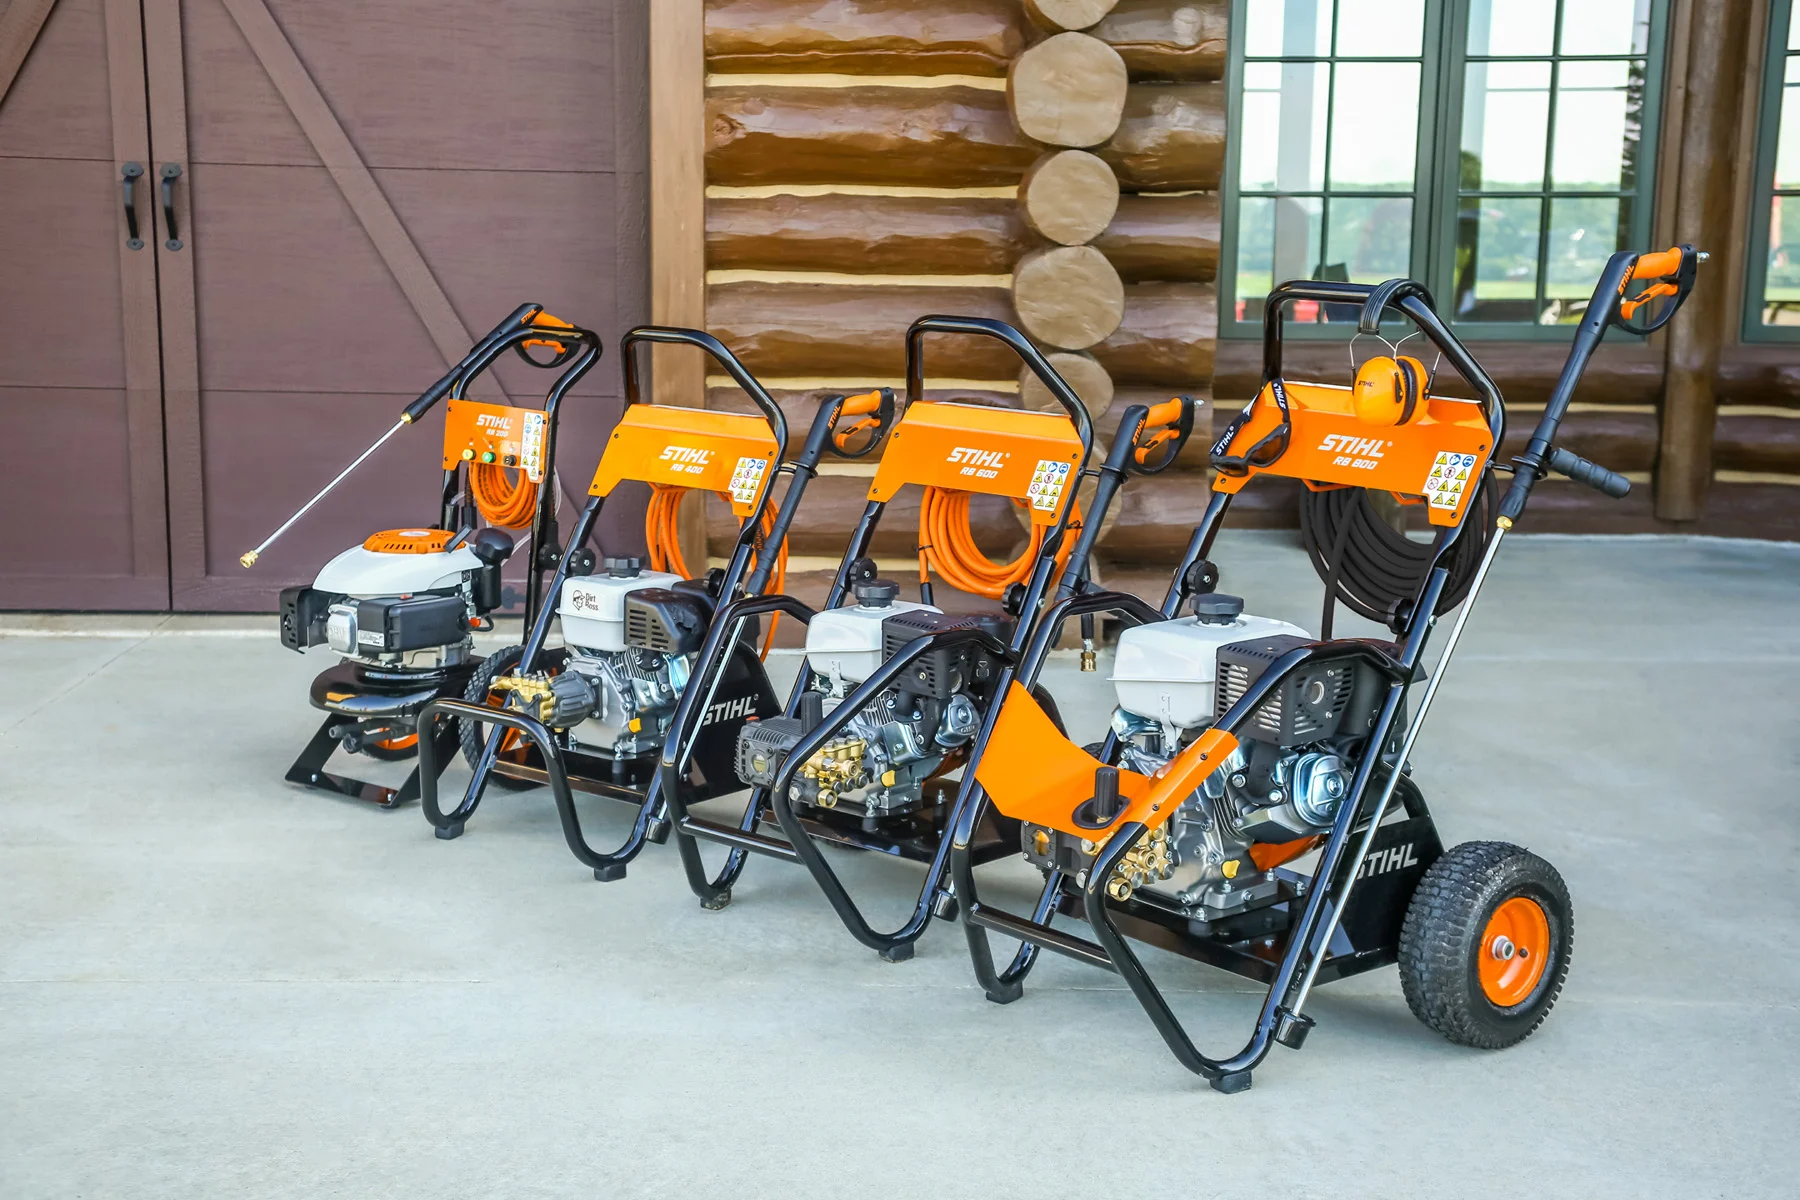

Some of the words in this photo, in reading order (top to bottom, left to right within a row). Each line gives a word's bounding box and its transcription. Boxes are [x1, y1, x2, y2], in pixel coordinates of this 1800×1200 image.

[1617, 265, 1635, 295] STIHL
[520, 308, 537, 325] STIHL
[1273, 385, 1287, 410] STIHL
[476, 413, 511, 430] STIHL
[828, 406, 841, 430] STIHL
[1132, 418, 1146, 446] STIHL
[1215, 430, 1235, 456] STIHL
[1318, 433, 1385, 458] STIHL
[659, 445, 710, 465] STIHL
[946, 446, 1005, 469] STIHL
[1332, 456, 1353, 467] RB
[1351, 458, 1379, 471] 800
[670, 463, 685, 473] RB
[685, 465, 705, 475] 400
[960, 466, 977, 476] RB
[975, 468, 999, 479] 600
[585, 592, 596, 603] Dirt
